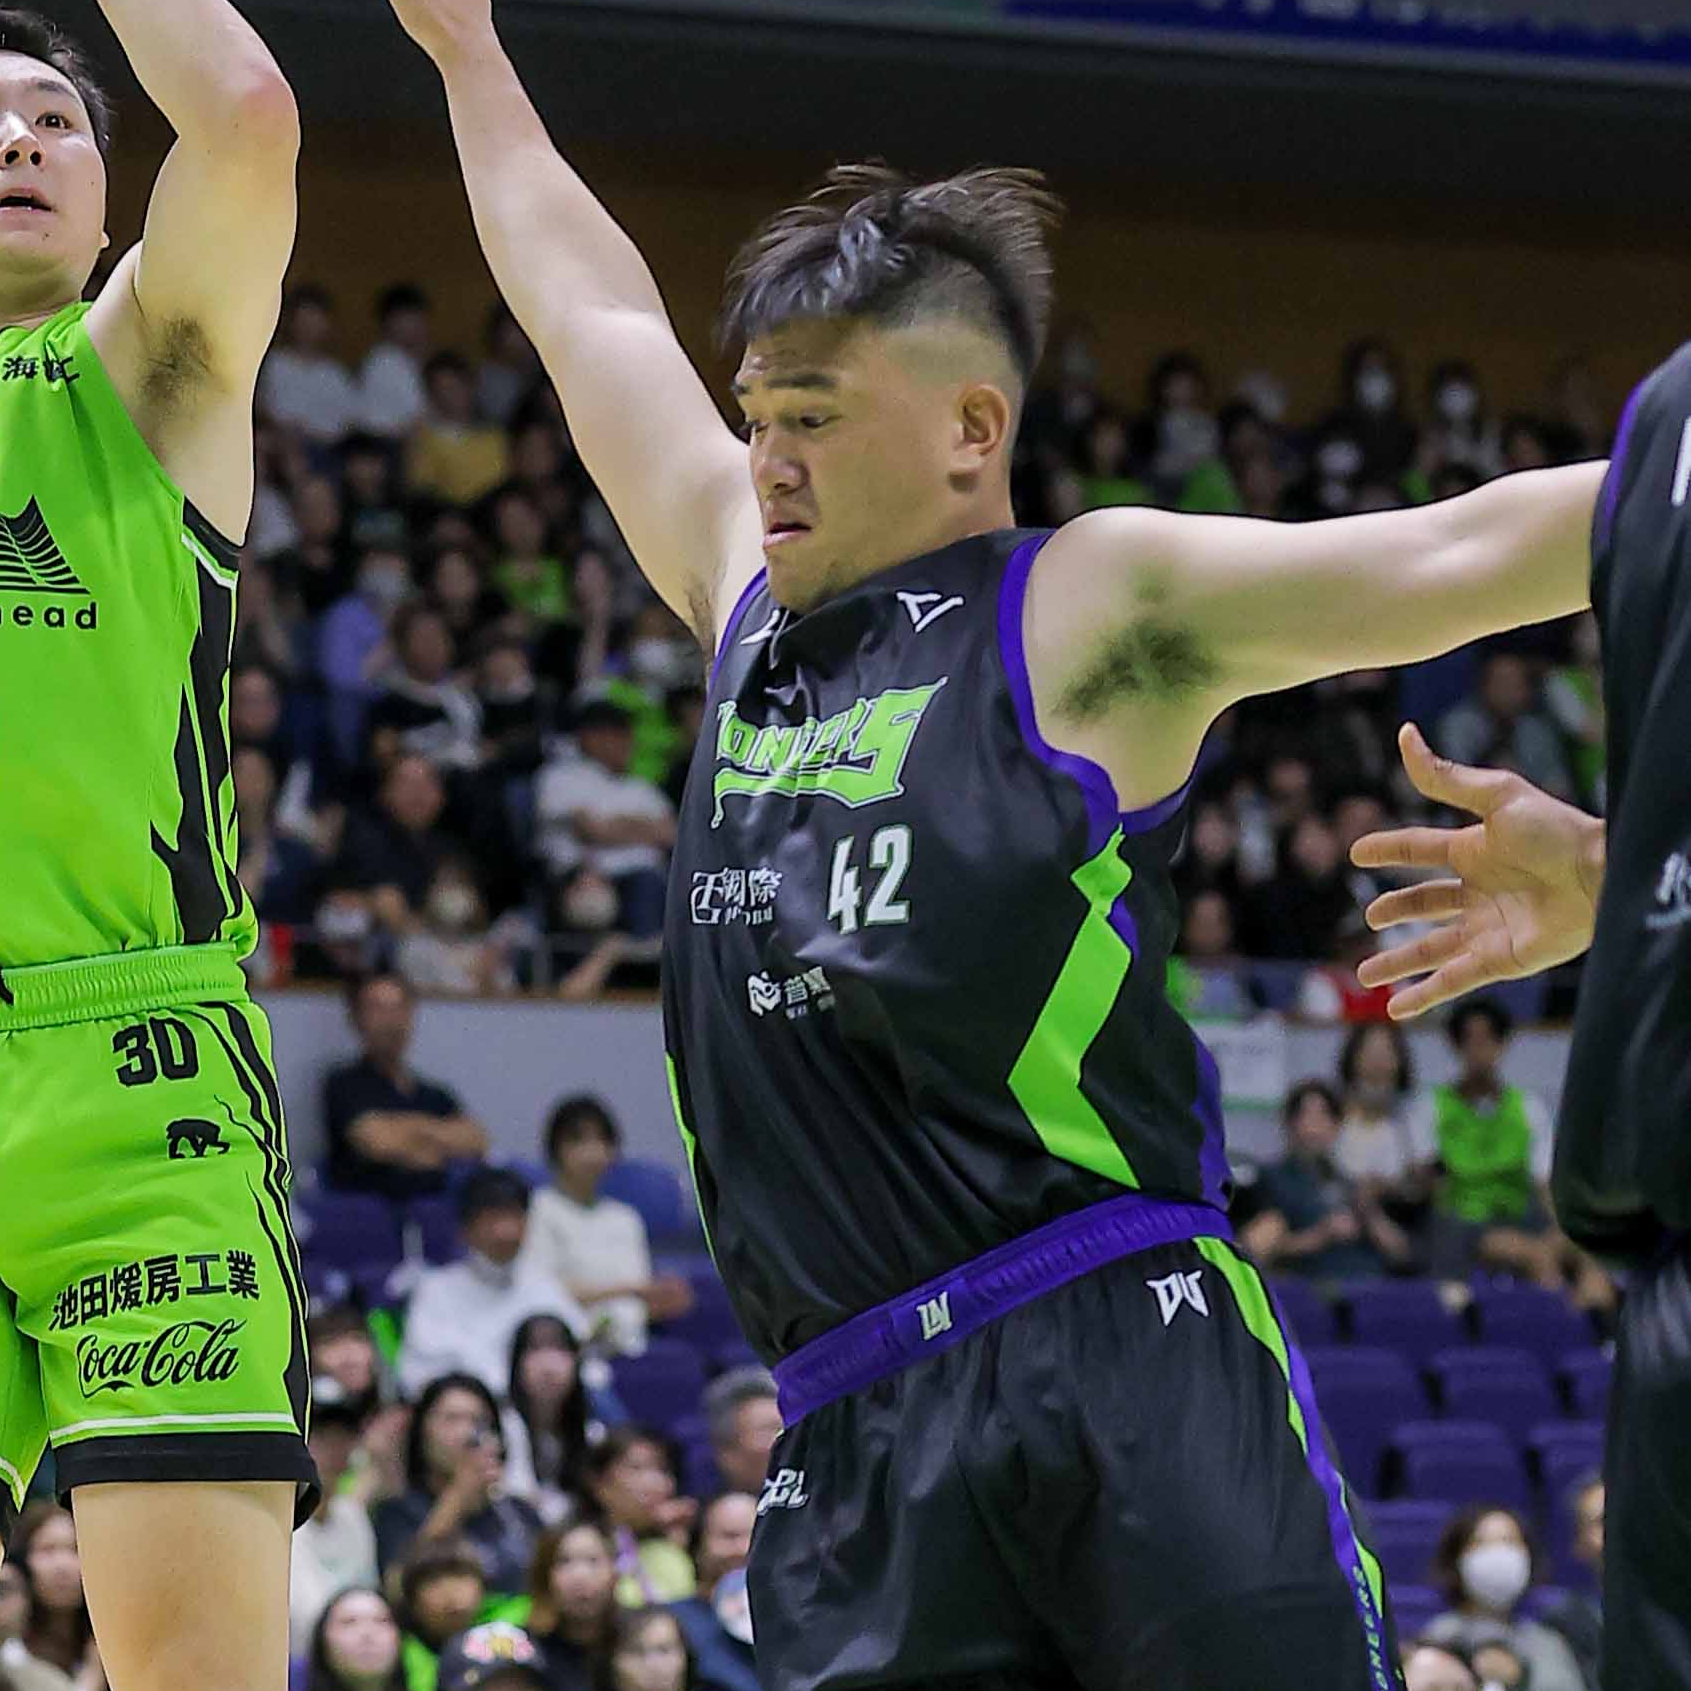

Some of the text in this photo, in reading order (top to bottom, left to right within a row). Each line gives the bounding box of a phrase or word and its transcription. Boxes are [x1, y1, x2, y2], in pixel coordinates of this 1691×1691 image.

[827, 824, 912, 936] 42
[112, 1016, 199, 1088] 30
[77, 1318, 248, 1399] Coca-Cola
